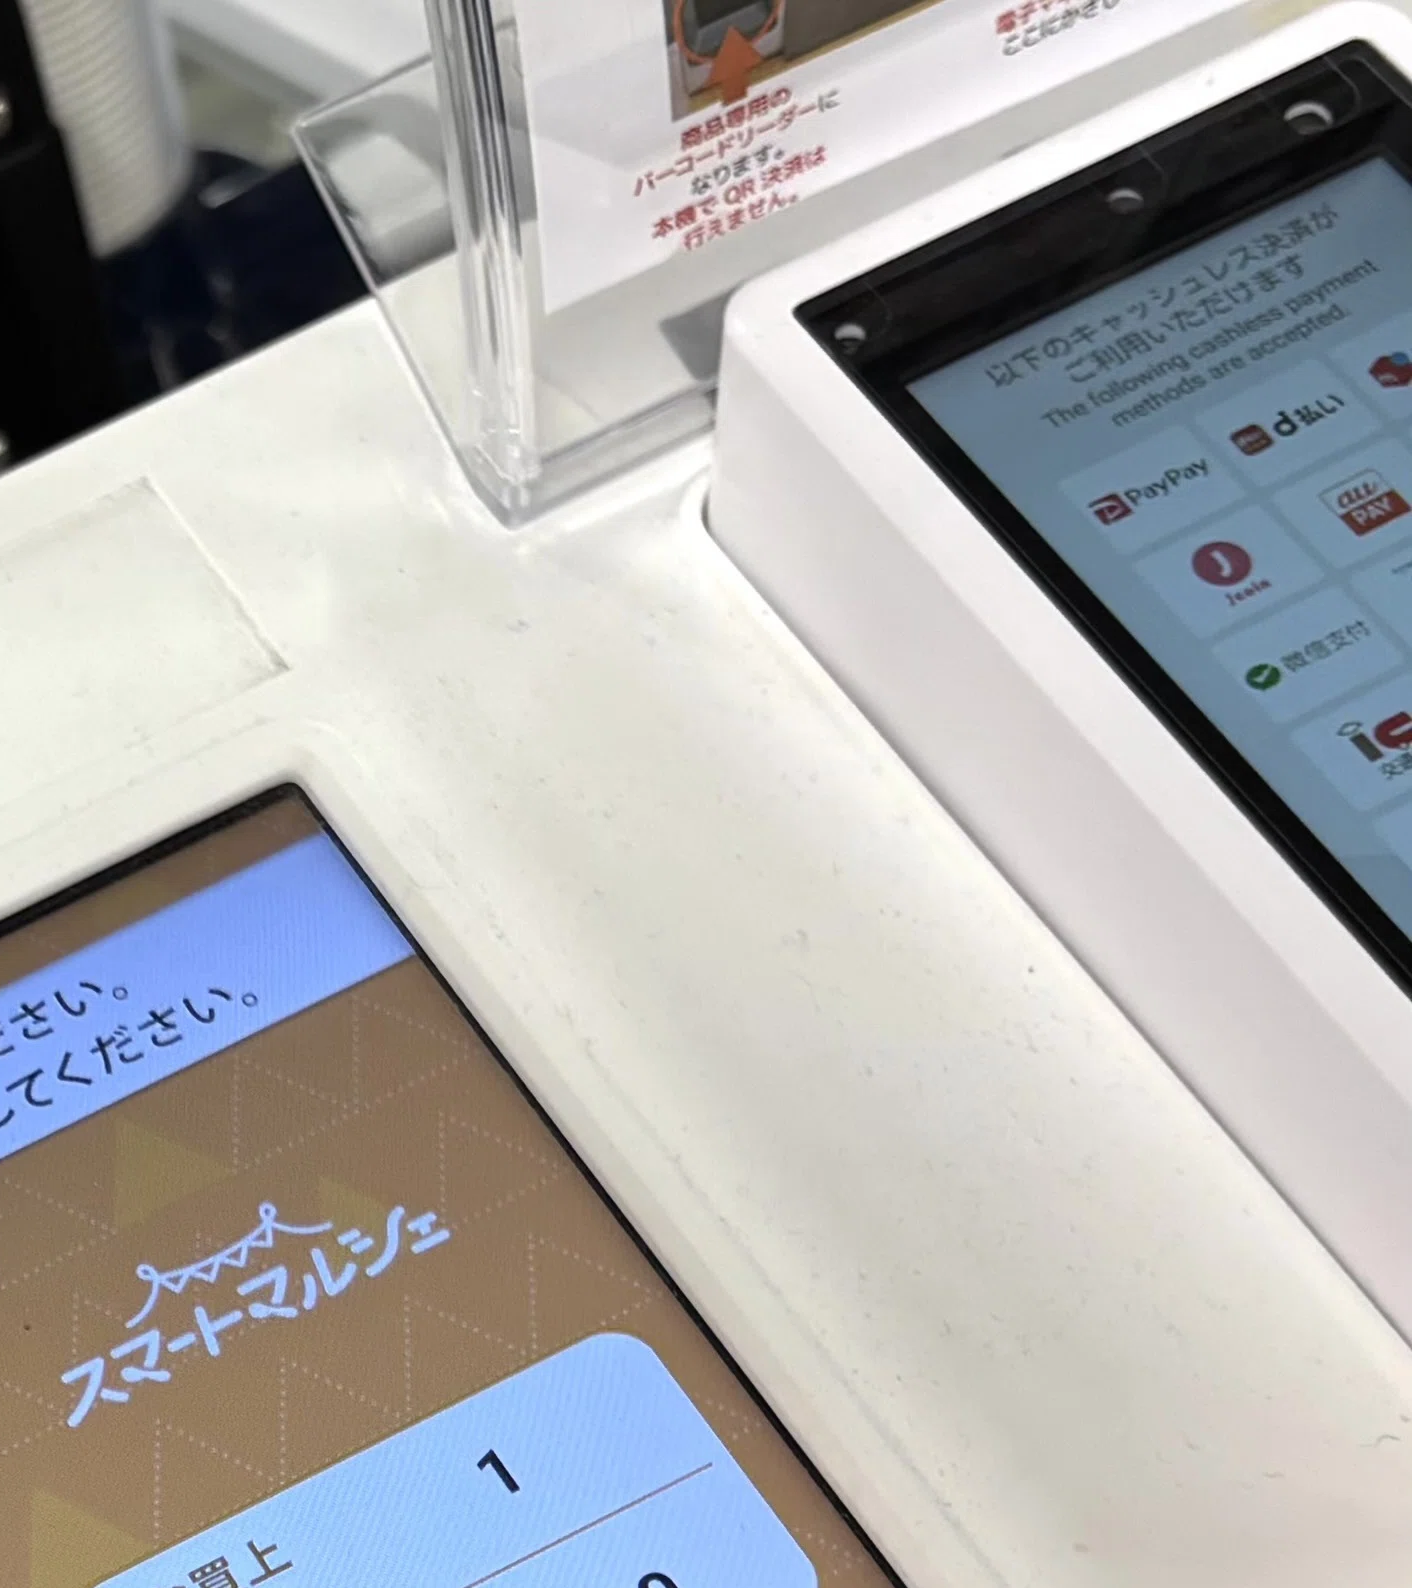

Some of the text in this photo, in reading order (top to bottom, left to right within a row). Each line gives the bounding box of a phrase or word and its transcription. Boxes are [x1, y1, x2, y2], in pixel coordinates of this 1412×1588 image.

[633, 88, 841, 197] バーコードリーダーに
[691, 144, 784, 196] なります。
[683, 193, 798, 250] 行えません。
[984, 203, 1339, 388] 以下のキャッシュレス決済が
[1041, 258, 1382, 429] The following cashless payment
[1063, 255, 1305, 384] ご利用いただけます
[1111, 302, 1352, 427] methods are accepted.
[1123, 458, 1210, 508] PayPay
[61, 1205, 451, 1428] スマートマルシェ
[477, 1449, 520, 1494] 1
